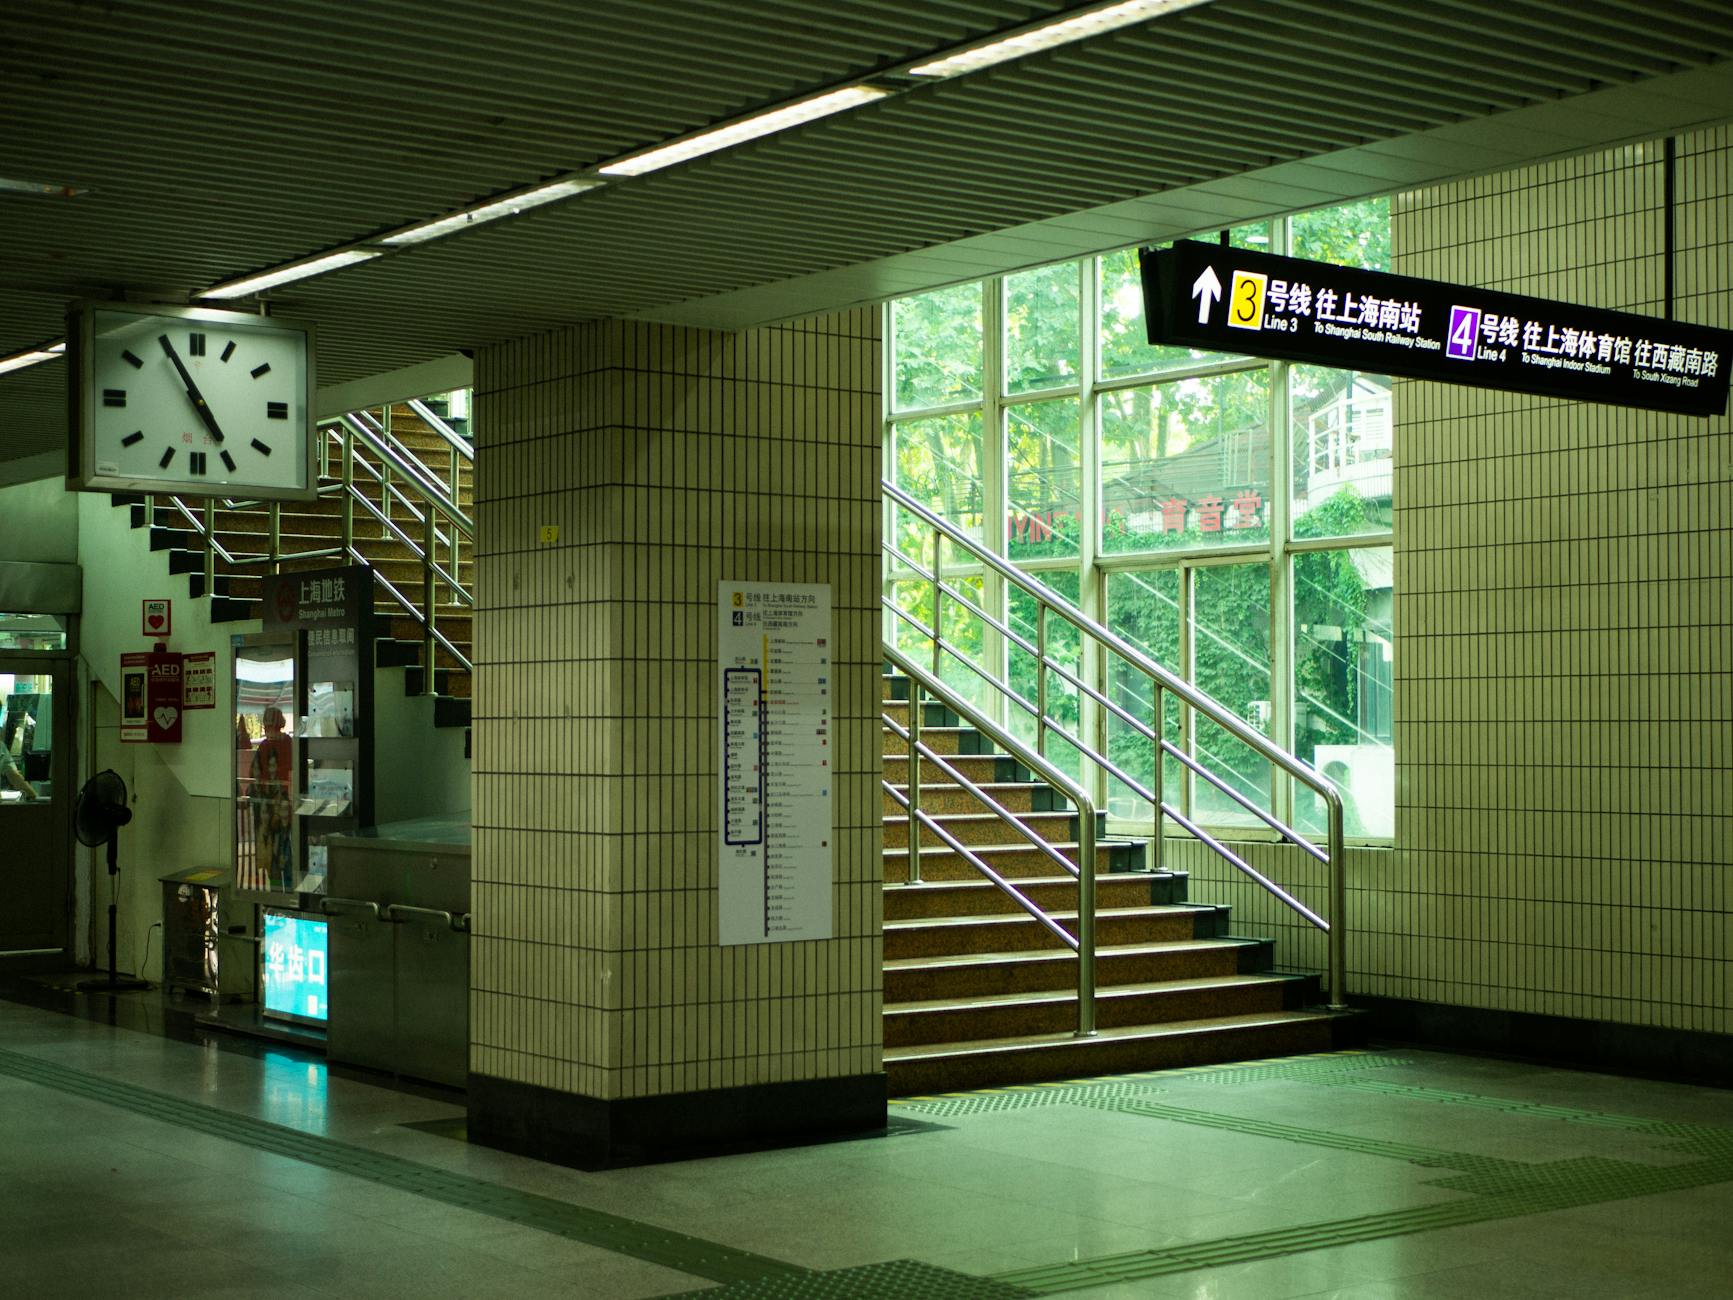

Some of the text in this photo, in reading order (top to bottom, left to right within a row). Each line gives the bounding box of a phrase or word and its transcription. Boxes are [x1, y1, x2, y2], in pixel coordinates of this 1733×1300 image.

[1237, 279, 1719, 378] 3 号线 往上海南站 4 号线 往上海体育馆 往西藏南路
[1264, 314, 1298, 333] Line 3
[1314, 321, 1441, 350] To Shanghai South Railway Station
[1477, 345, 1507, 363] Line 4
[1521, 352, 1611, 375] To Shanghai Indoor Stadium
[1632, 368, 1699, 388] To South Xizang Road
[298, 577, 345, 604] 上海地铁
[733, 592, 742, 607] 3
[733, 611, 743, 625] 4
[151, 664, 180, 676] AED
